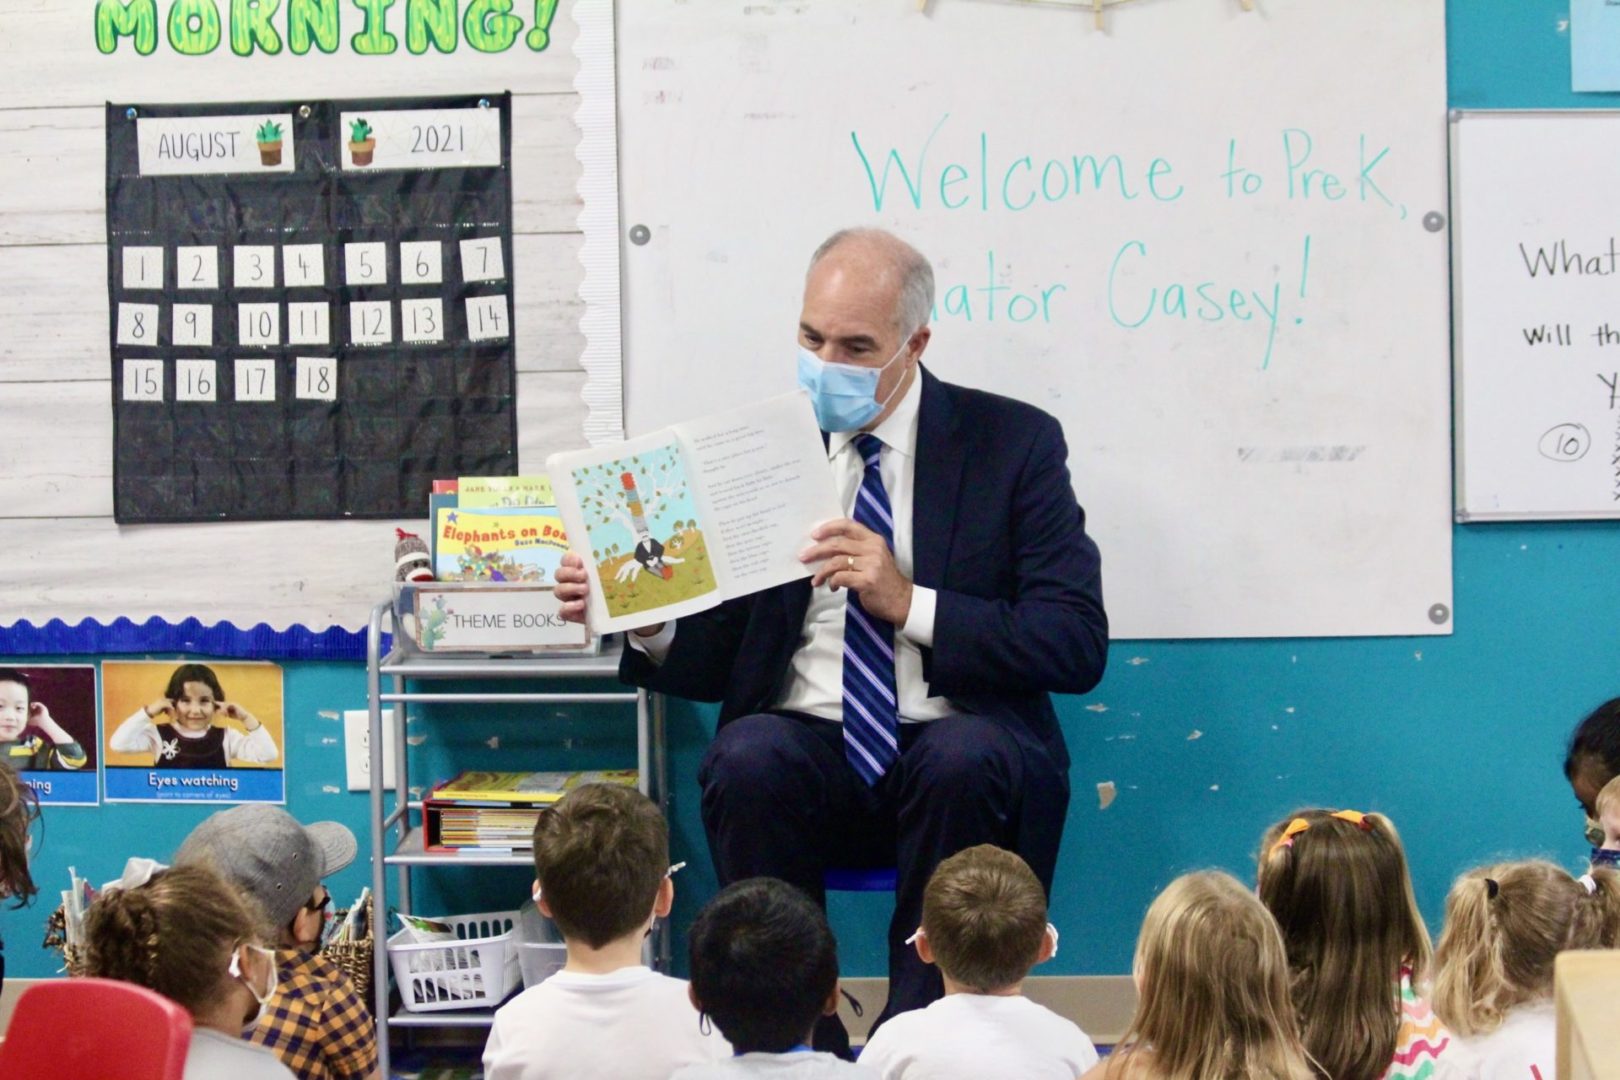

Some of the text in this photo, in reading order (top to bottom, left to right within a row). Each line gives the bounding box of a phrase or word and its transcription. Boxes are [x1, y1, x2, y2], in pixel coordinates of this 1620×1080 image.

[94, 0, 560, 56] MORNING!
[158, 131, 241, 161] AUGUST
[410, 124, 465, 154] 2021
[850, 112, 1185, 213] Welcome
[1221, 138, 1264, 199] to
[191, 254, 205, 282] 2
[251, 254, 263, 281] 3
[297, 253, 310, 279] 4
[359, 252, 373, 278] 5
[415, 250, 430, 278] 6
[475, 246, 488, 274] 7
[1518, 237, 1620, 279] What
[931, 233, 1313, 371] ator Casey!
[131, 303, 502, 339] 8 9 10 11 12 13 14
[1523, 323, 1571, 347] will
[133, 366, 330, 395] 15 16 17 18
[1556, 432, 1581, 456] 10
[442, 525, 516, 545] Elephants
[521, 527, 538, 537] on
[453, 613, 567, 629] THEME BOOKS
[149, 772, 239, 791] Eyes watching
